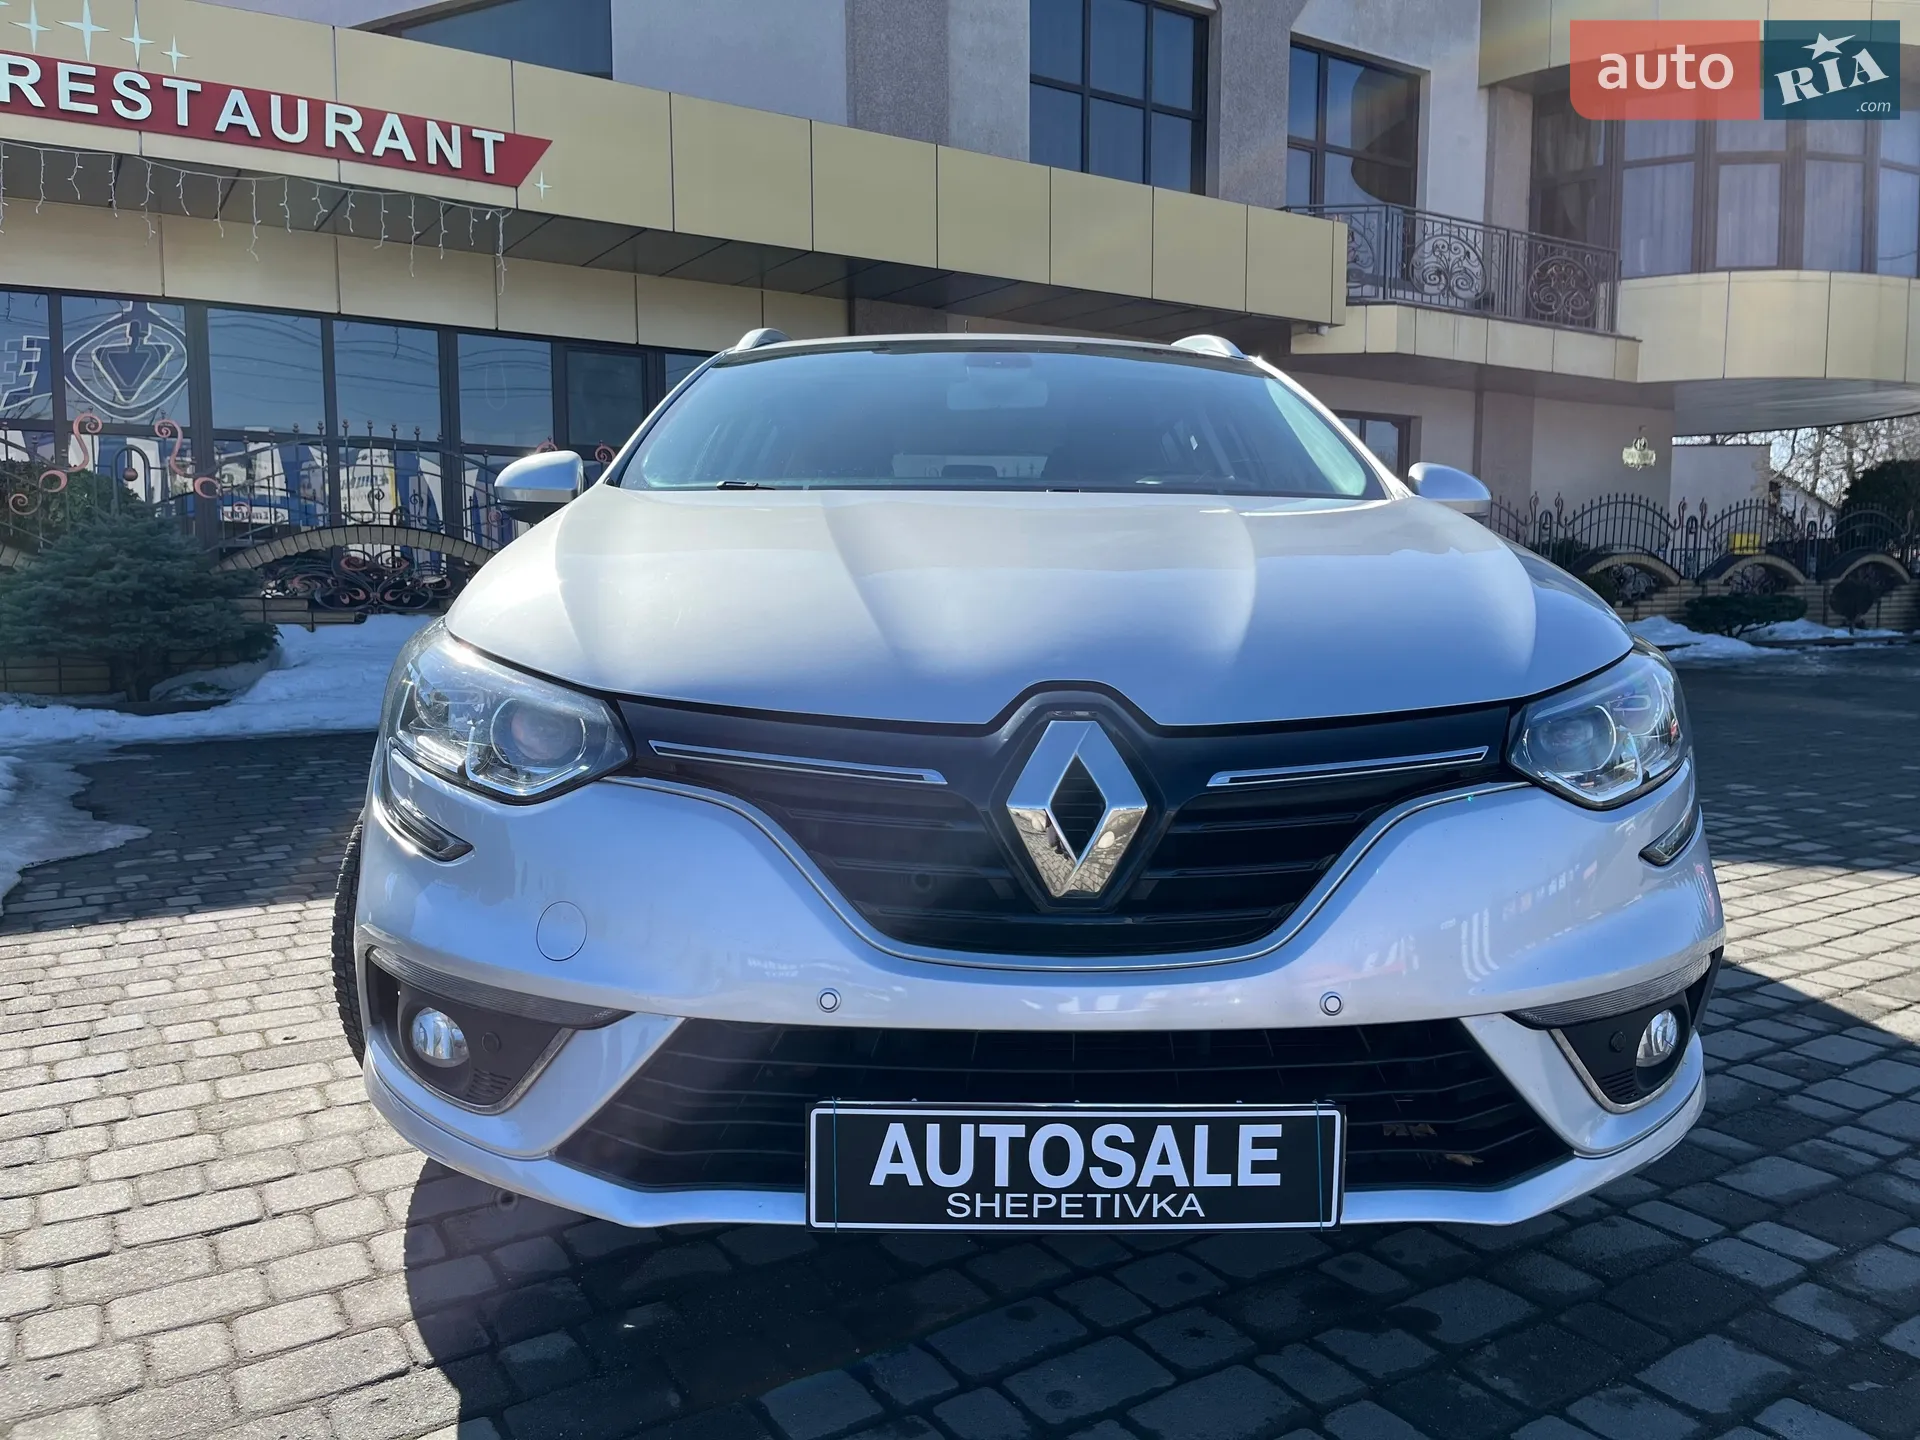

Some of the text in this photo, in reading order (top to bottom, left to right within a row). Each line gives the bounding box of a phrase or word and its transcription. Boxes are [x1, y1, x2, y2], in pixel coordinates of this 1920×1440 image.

[0, 53, 505, 175] RESTAURANT
[869, 1122, 1282, 1189] AUTOSALE
[946, 1192, 1206, 1219] SHEPETIVKA
